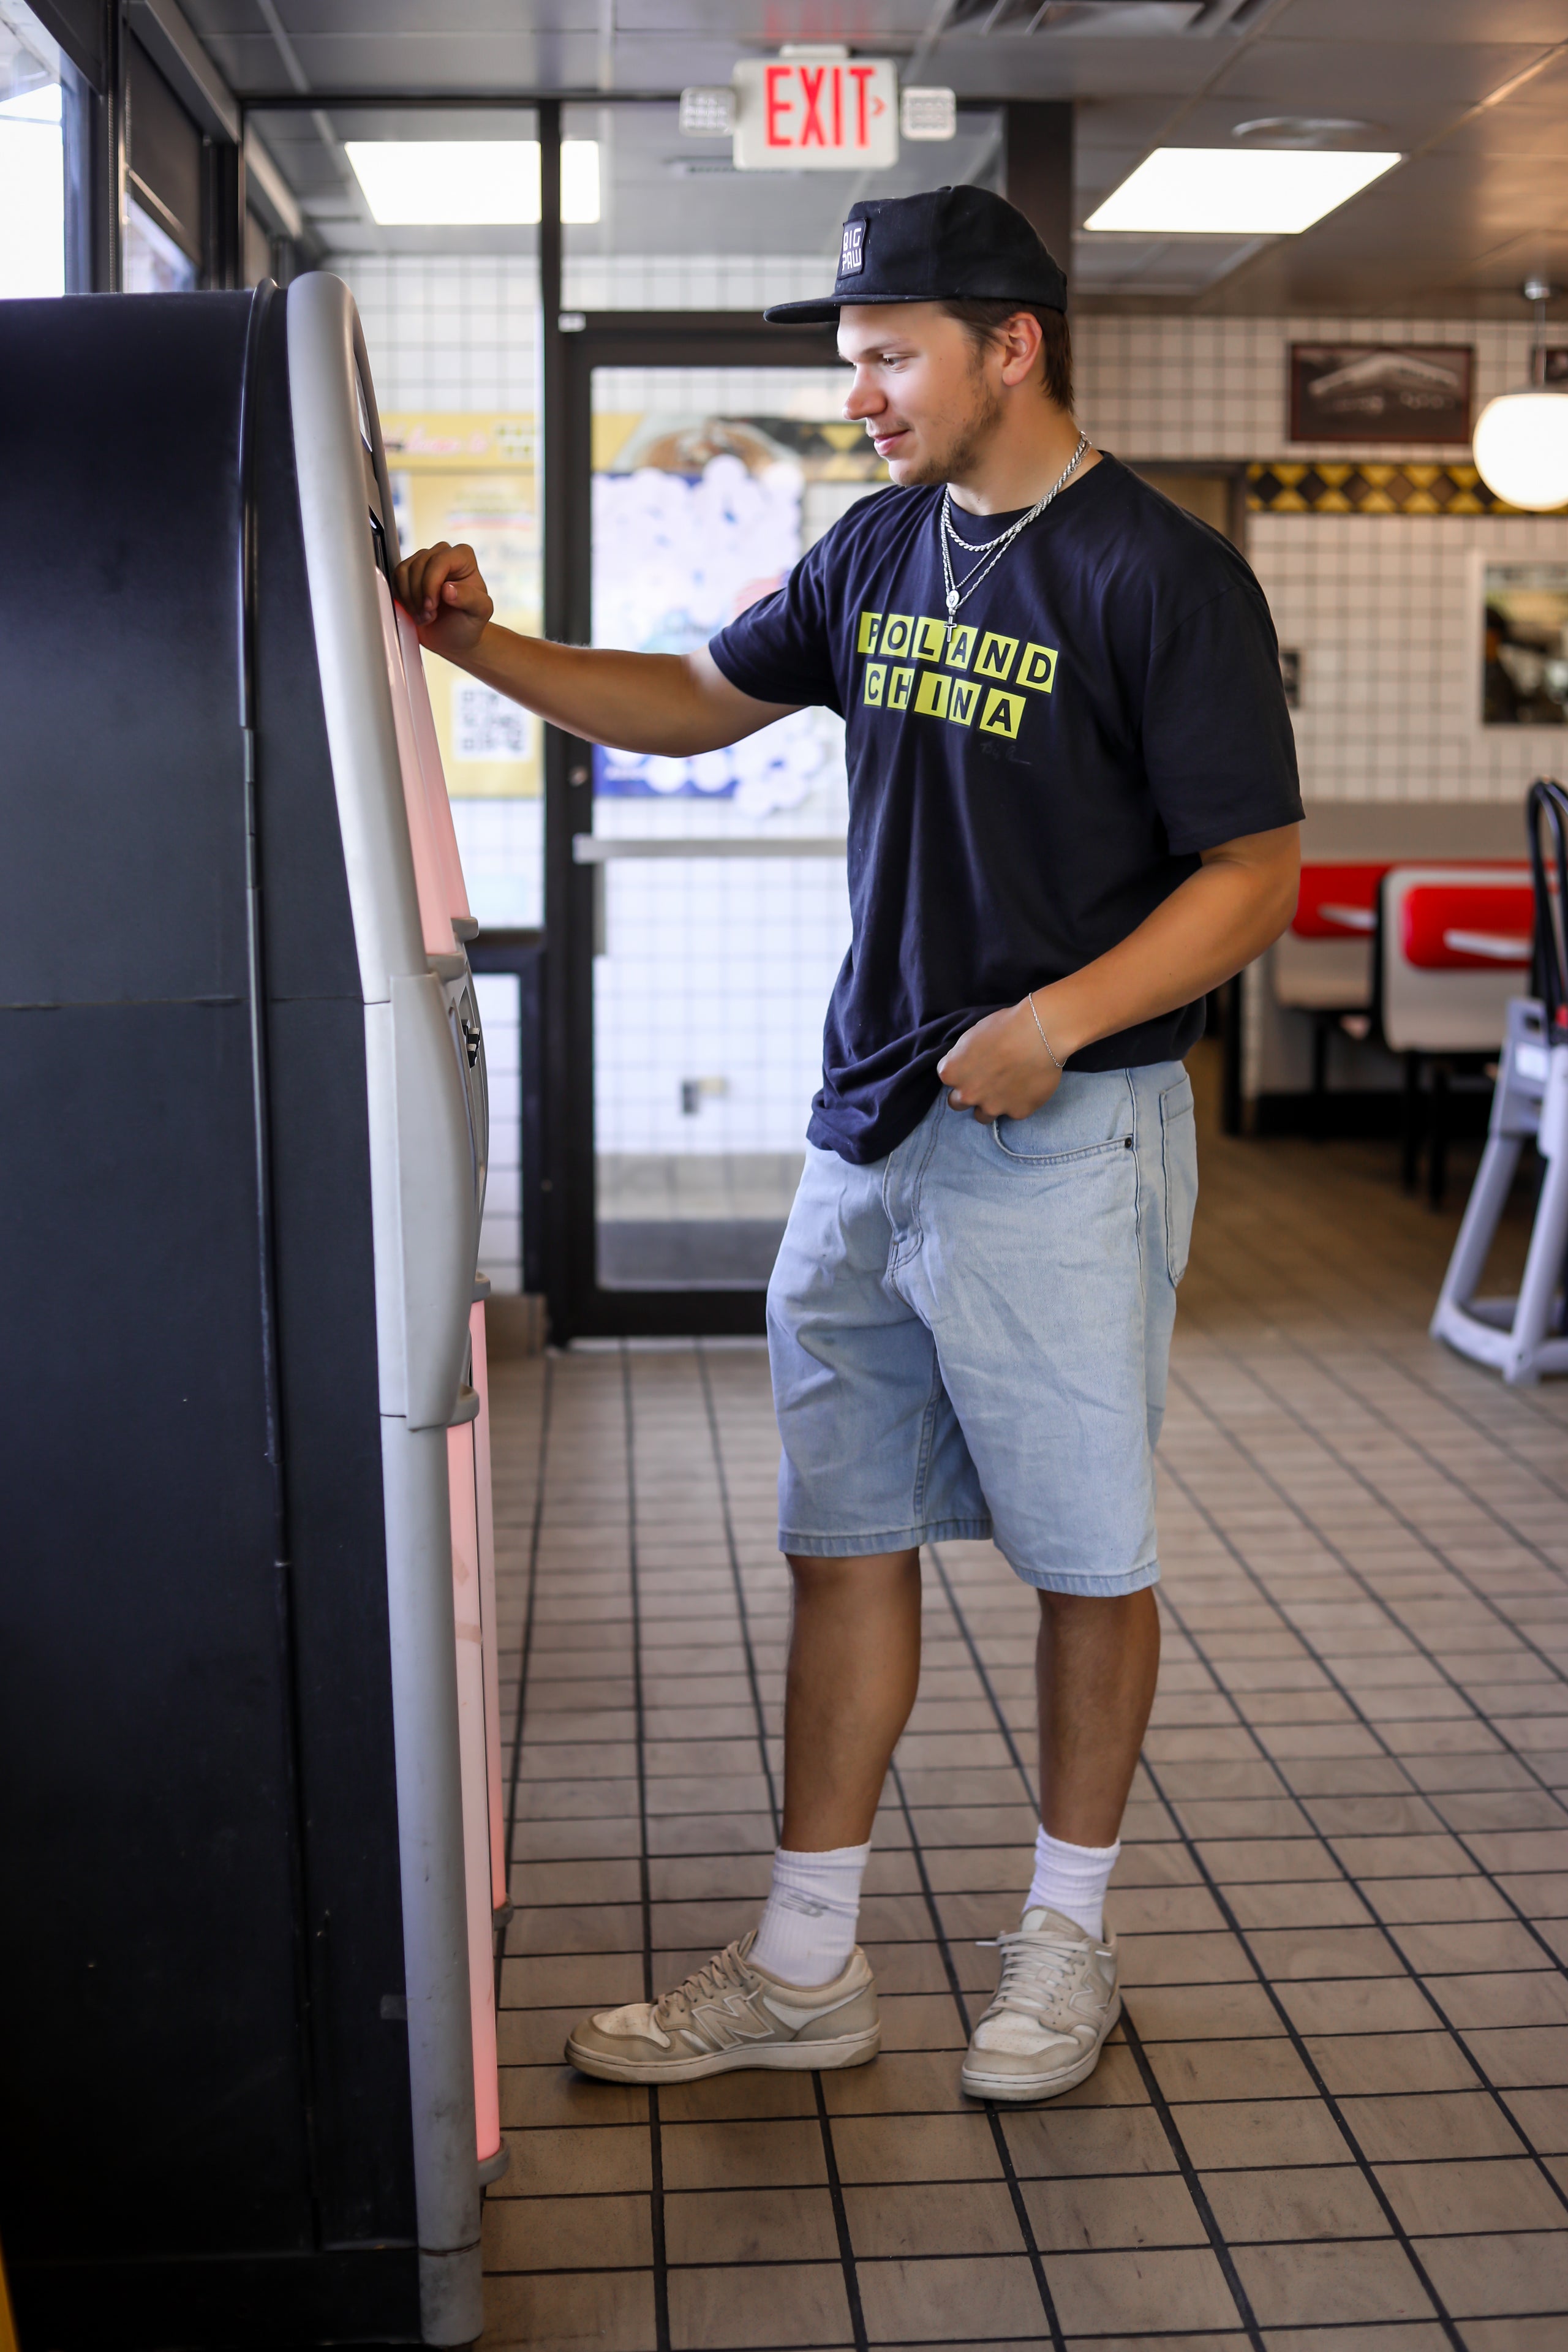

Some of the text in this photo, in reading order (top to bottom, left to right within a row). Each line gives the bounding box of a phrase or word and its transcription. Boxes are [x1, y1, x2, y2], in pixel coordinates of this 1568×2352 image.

[764, 65, 876, 149] EXIT
[842, 247, 862, 271] PAW
[843, 227, 862, 252] BIG
[867, 617, 1052, 684] POLAND
[868, 669, 1012, 733] CHINA
